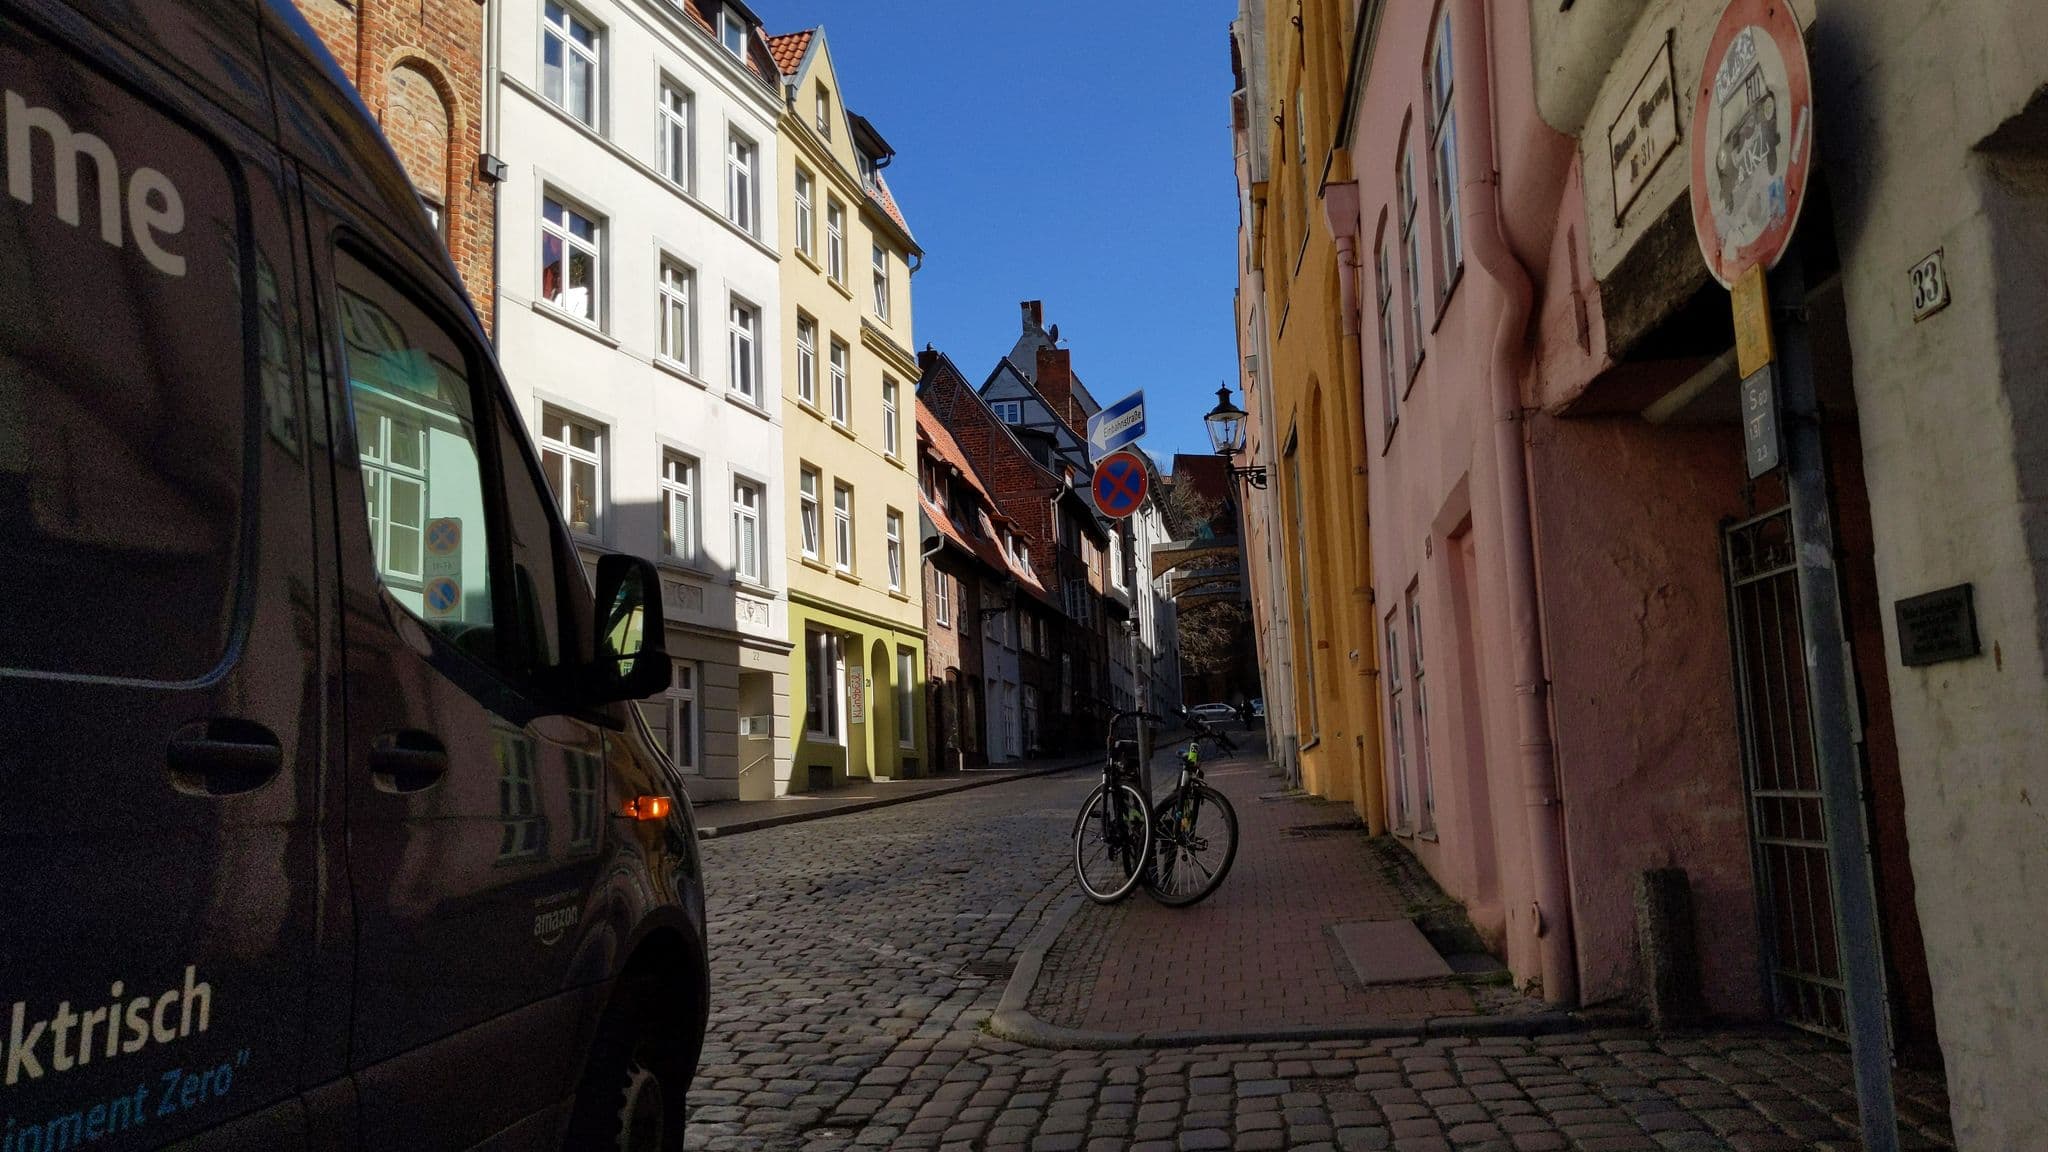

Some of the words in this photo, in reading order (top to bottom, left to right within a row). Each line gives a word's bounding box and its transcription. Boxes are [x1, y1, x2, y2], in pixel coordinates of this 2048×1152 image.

[1912, 260, 1939, 309] 33
[1103, 409, 1142, 438] Einbahnstraße
[533, 904, 579, 937] amazon
[0, 963, 212, 1086] ktrisch
